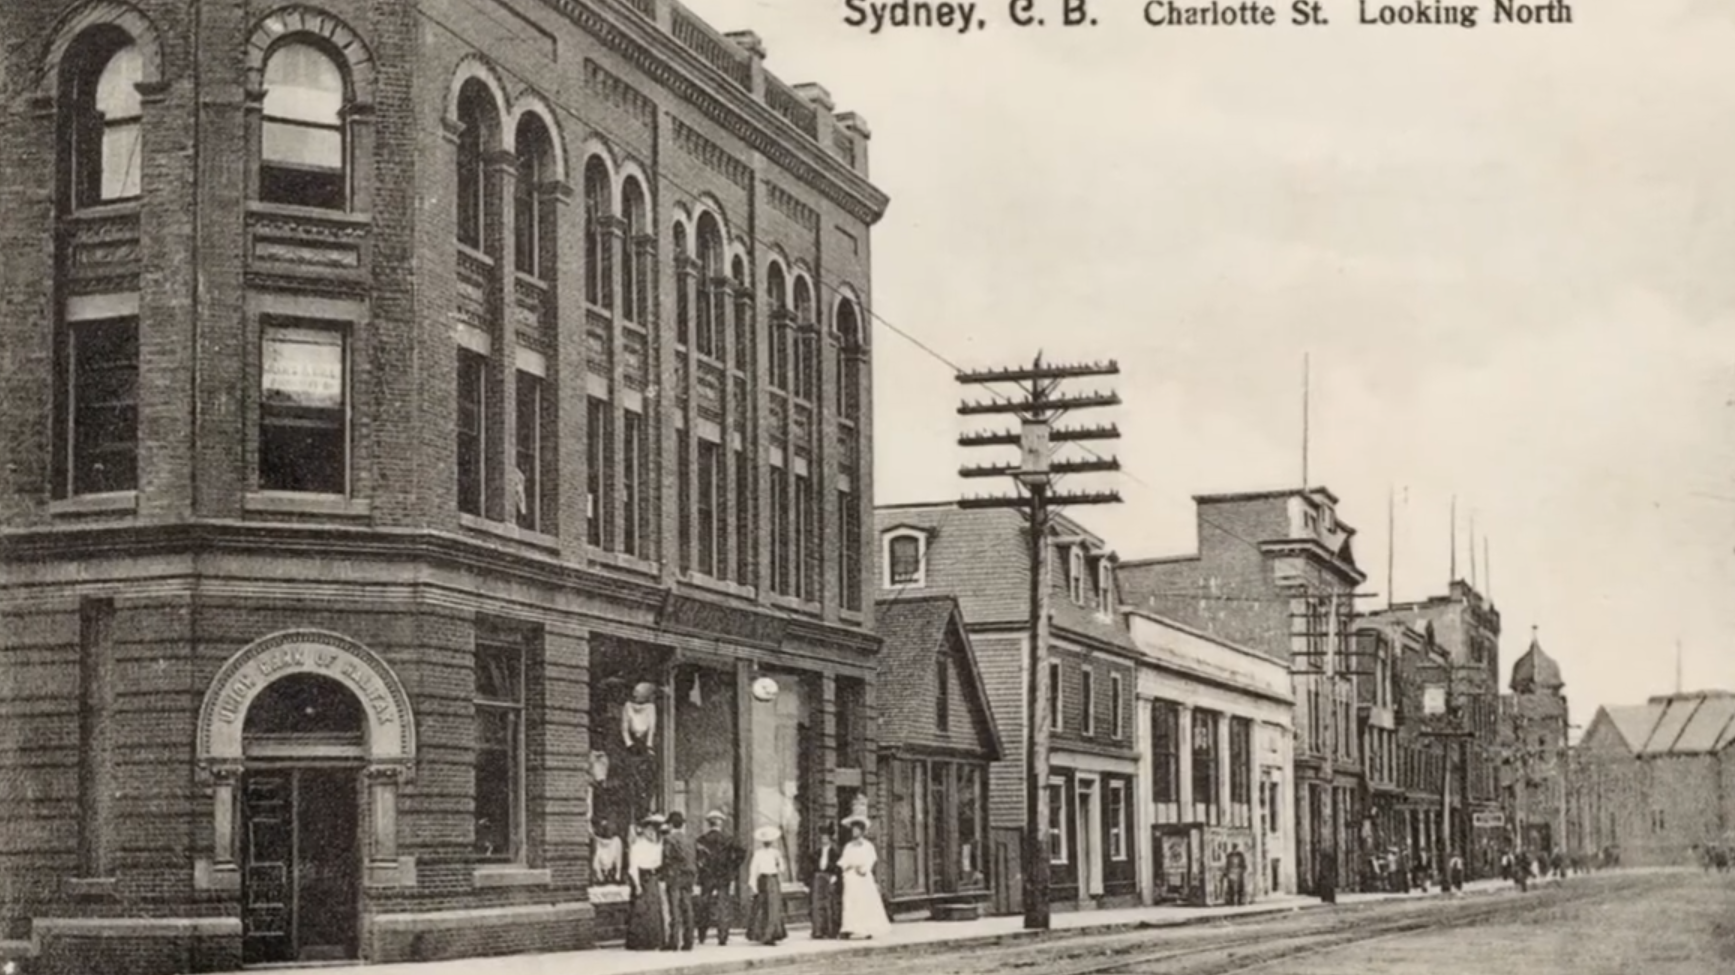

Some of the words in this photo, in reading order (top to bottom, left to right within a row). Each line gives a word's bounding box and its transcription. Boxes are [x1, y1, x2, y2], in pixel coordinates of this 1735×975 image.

[218, 673, 257, 725] UNION
[257, 646, 306, 677] BANK
[314, 651, 340, 669] OF
[341, 661, 395, 726] HALIFAX
